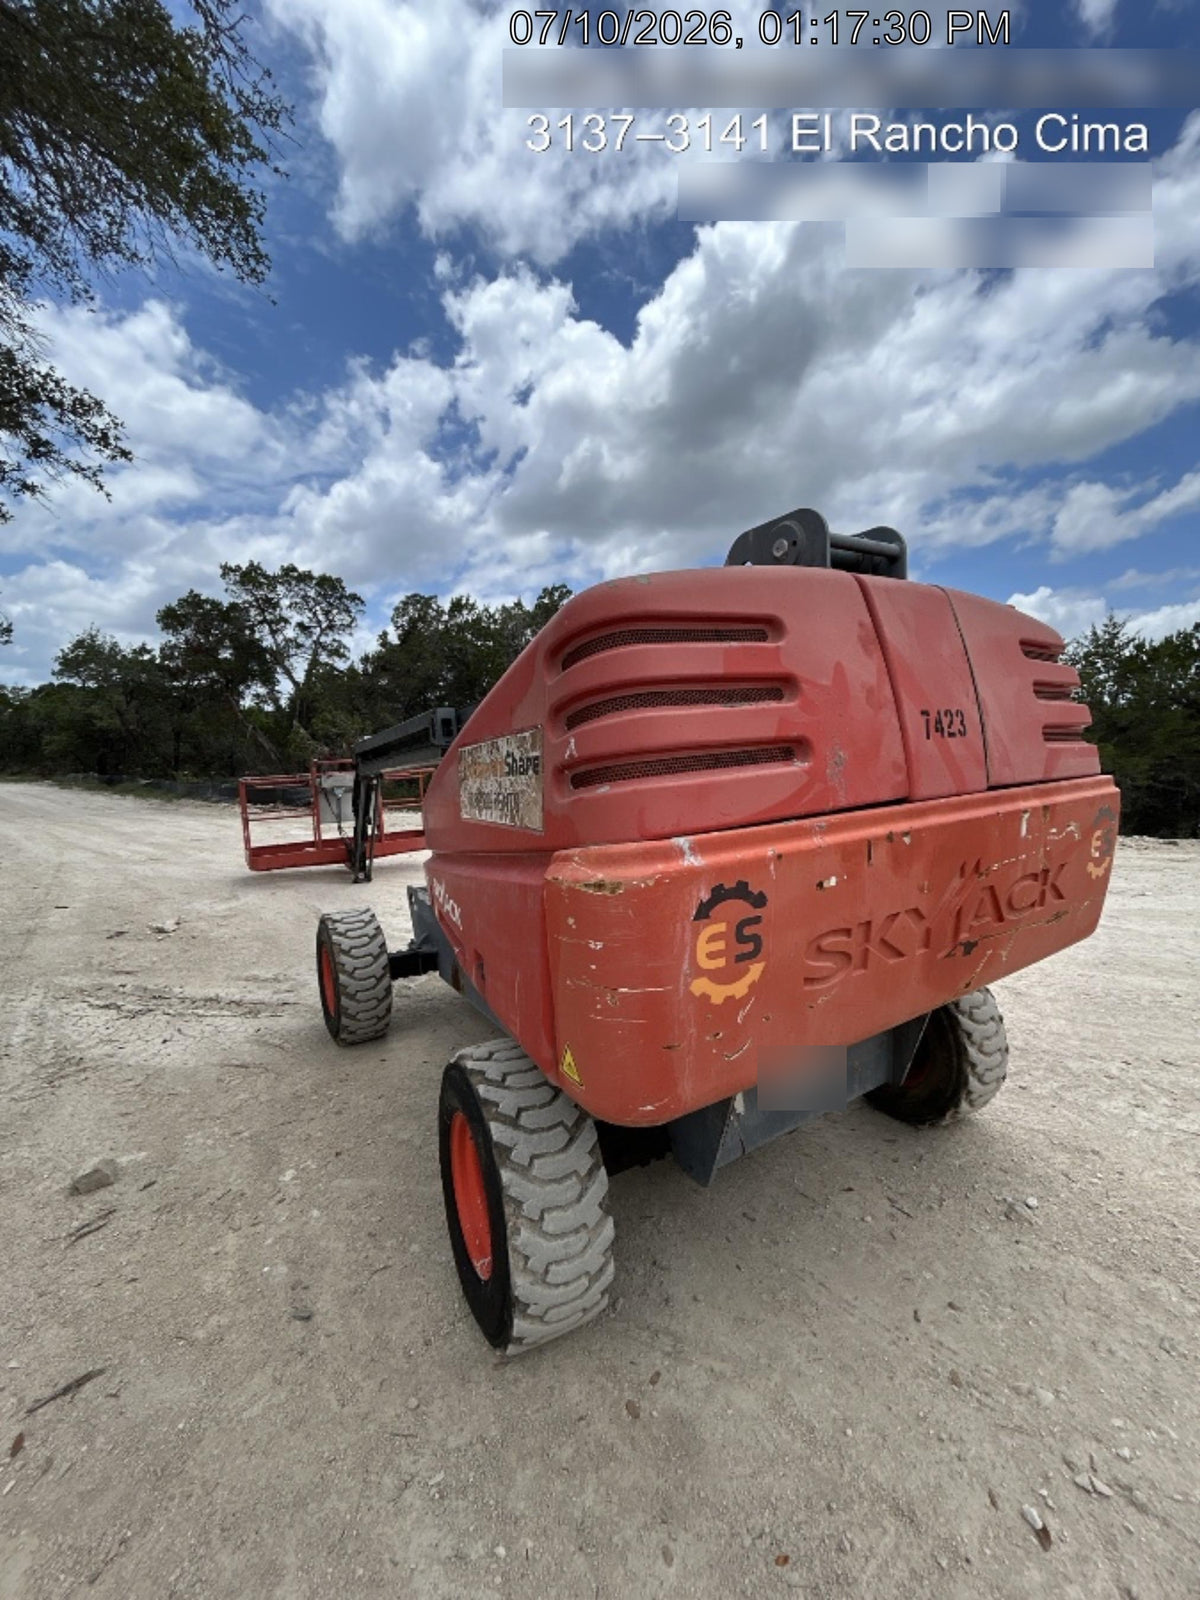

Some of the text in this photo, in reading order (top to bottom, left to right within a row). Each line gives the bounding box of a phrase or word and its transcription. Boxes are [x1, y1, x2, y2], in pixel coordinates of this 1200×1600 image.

[920, 708, 967, 740] 7423
[696, 915, 763, 970] ES
[802, 858, 1067, 990] SKYJACK
